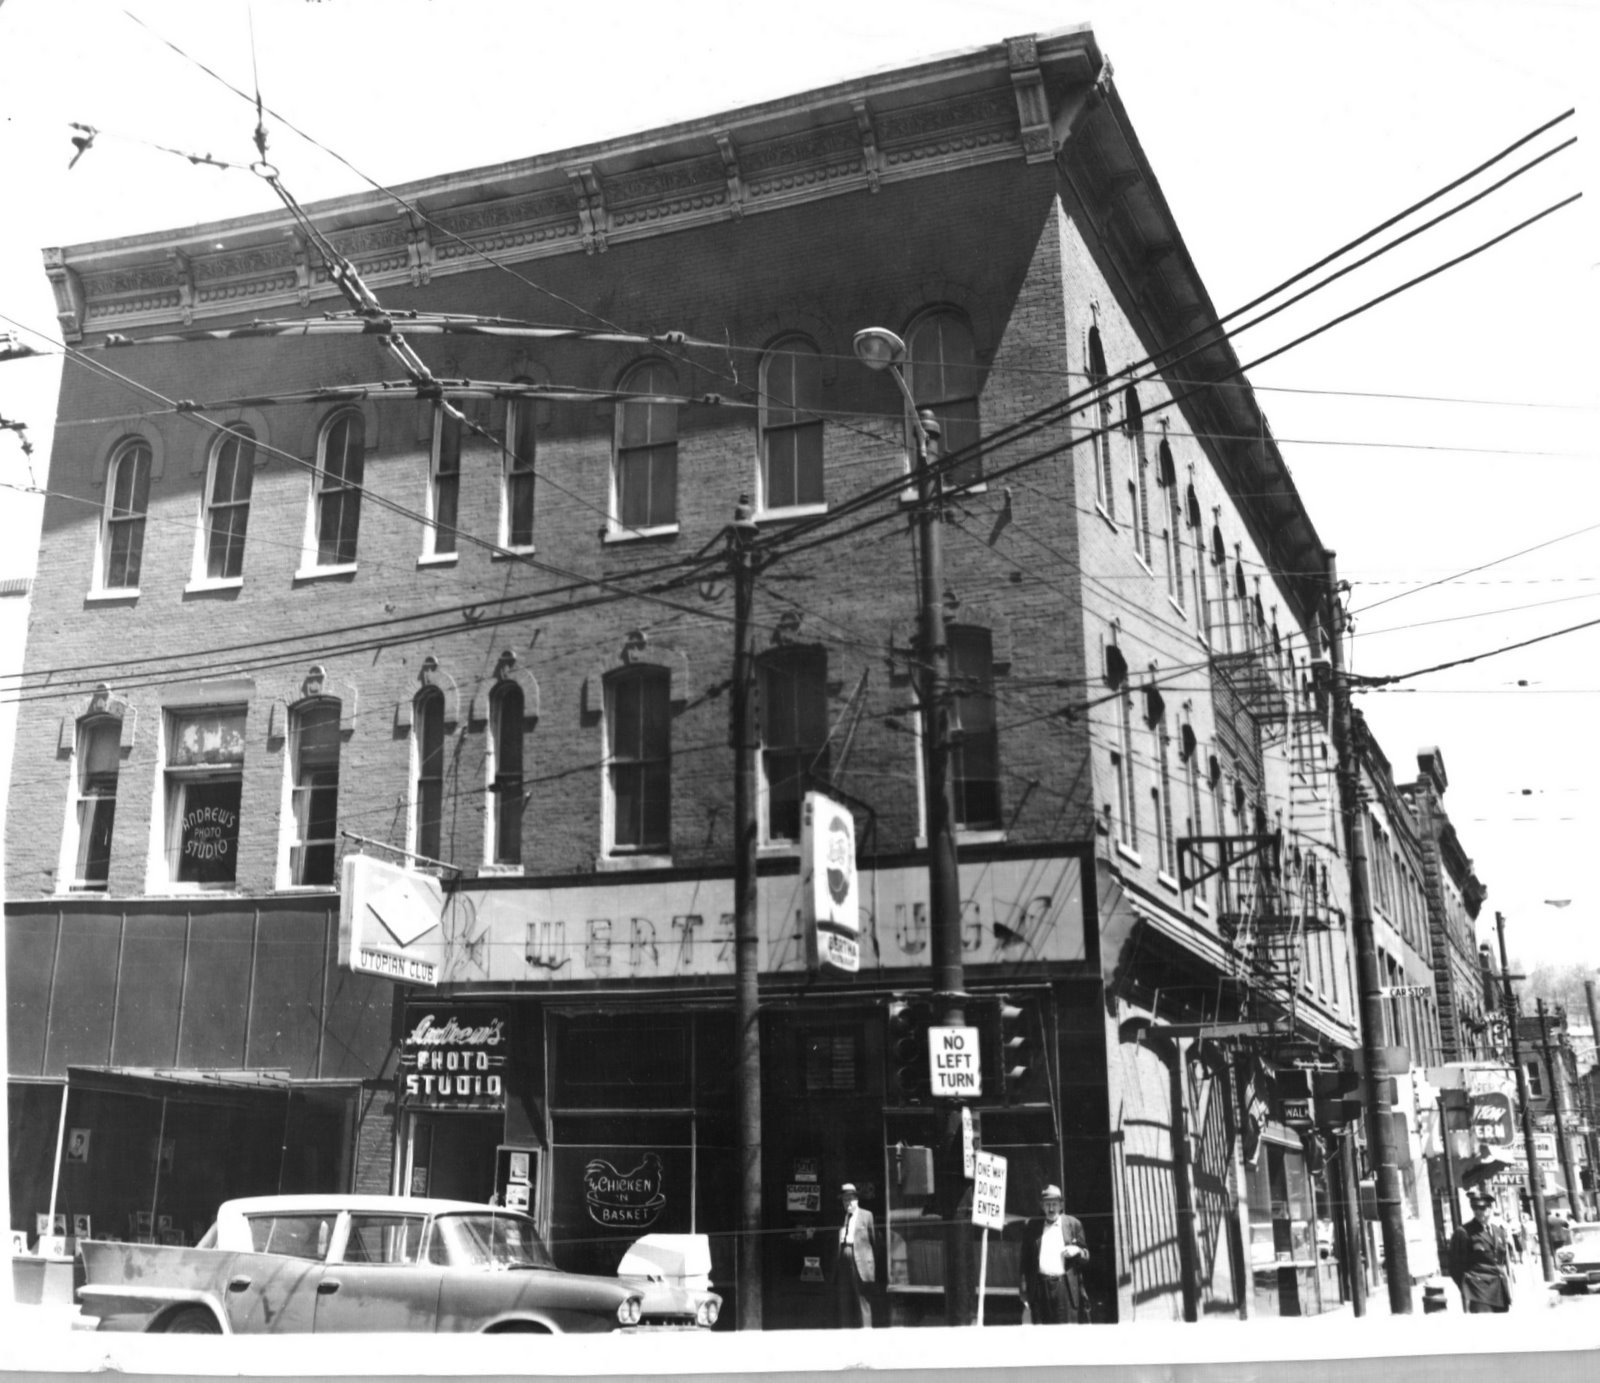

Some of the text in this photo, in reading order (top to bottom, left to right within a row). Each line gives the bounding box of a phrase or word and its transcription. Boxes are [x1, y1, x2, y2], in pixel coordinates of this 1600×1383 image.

[194, 827, 221, 837] PHOTO
[185, 839, 228, 859] STUDIO
[361, 949, 434, 981] UTOPIAN CLUB
[1390, 987, 1407, 998] CAR
[943, 1035, 965, 1051] NO
[417, 1050, 489, 1071] PHOTO
[937, 1053, 972, 1069] LEFT
[406, 1074, 502, 1096] STUDIO
[938, 1072, 975, 1088] TURN
[977, 1161, 1006, 1182] ONE WAY
[598, 1176, 652, 1193] CHICKEN
[787, 1185, 819, 1194] CLOSED
[977, 1180, 1003, 1199] DO NOT
[616, 1193, 629, 1202] IN
[602, 1208, 649, 1222] BASKET
[977, 1199, 1001, 1217] ENTER
